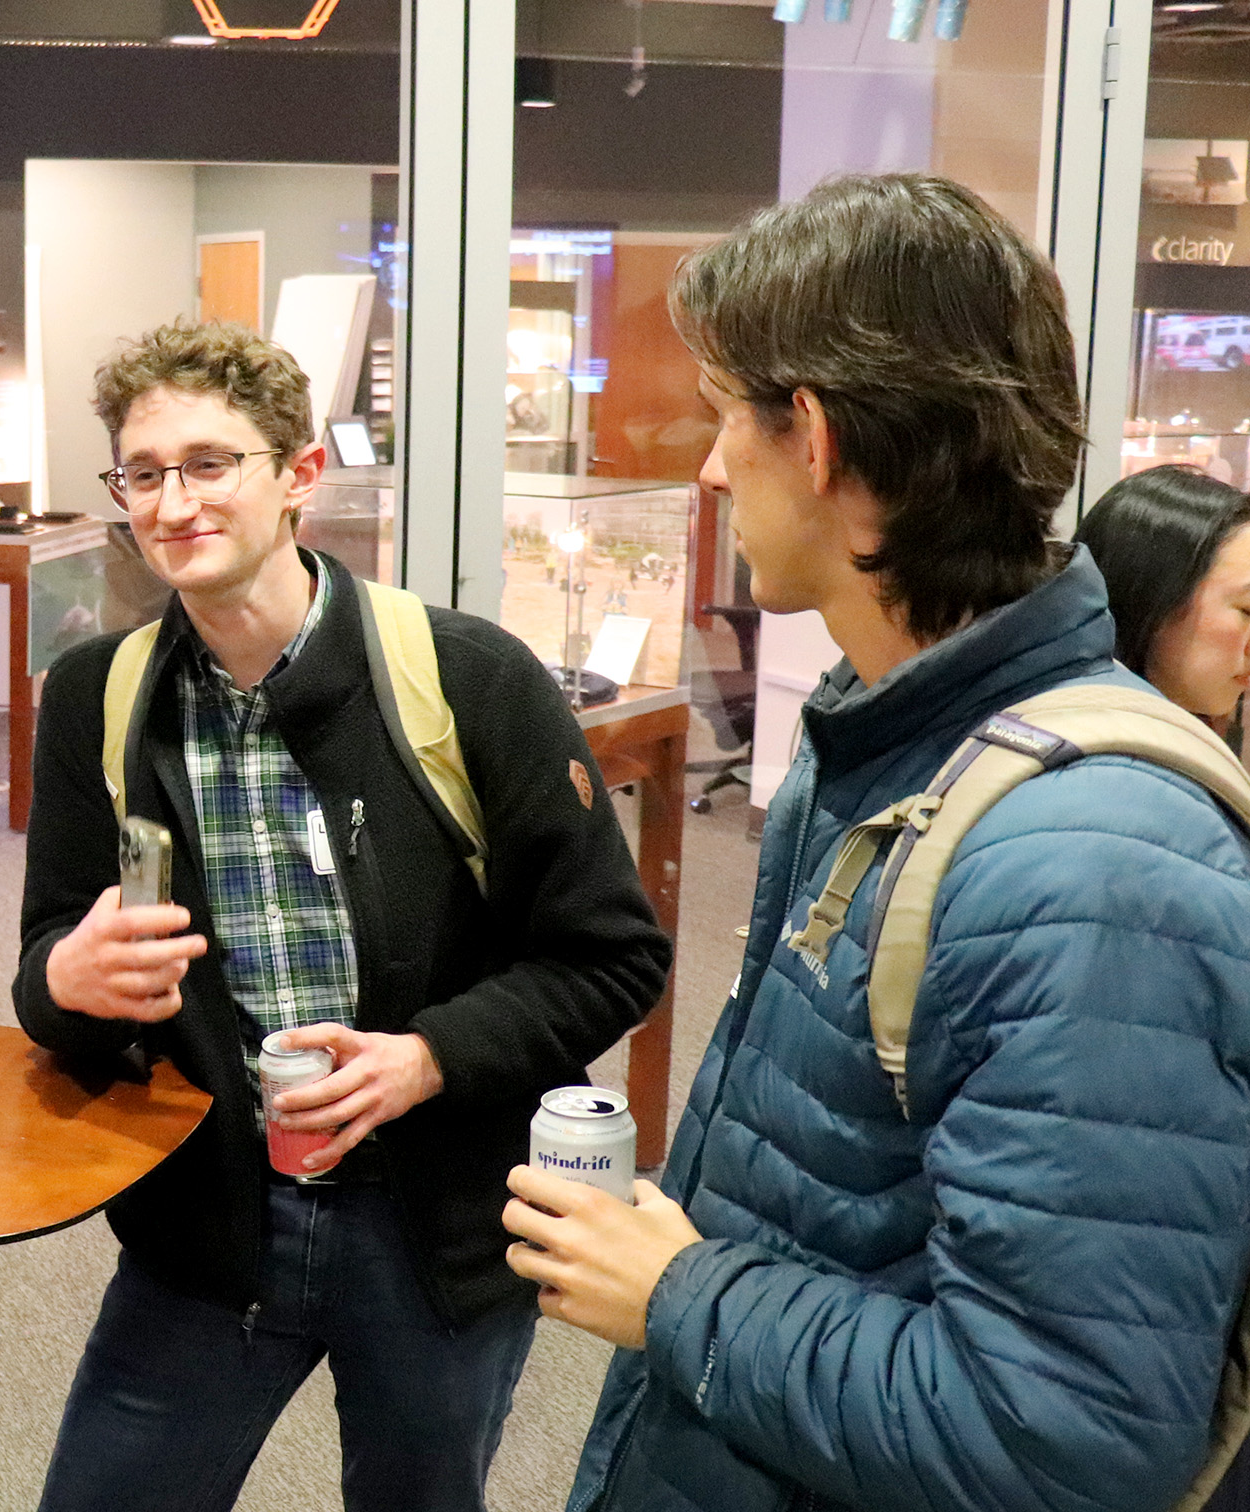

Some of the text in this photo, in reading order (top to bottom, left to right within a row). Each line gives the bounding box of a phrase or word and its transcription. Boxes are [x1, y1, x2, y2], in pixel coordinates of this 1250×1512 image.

[1168, 236, 1234, 266] clarity
[986, 725, 1042, 750] patagonia
[538, 1151, 613, 1170] spindrift
